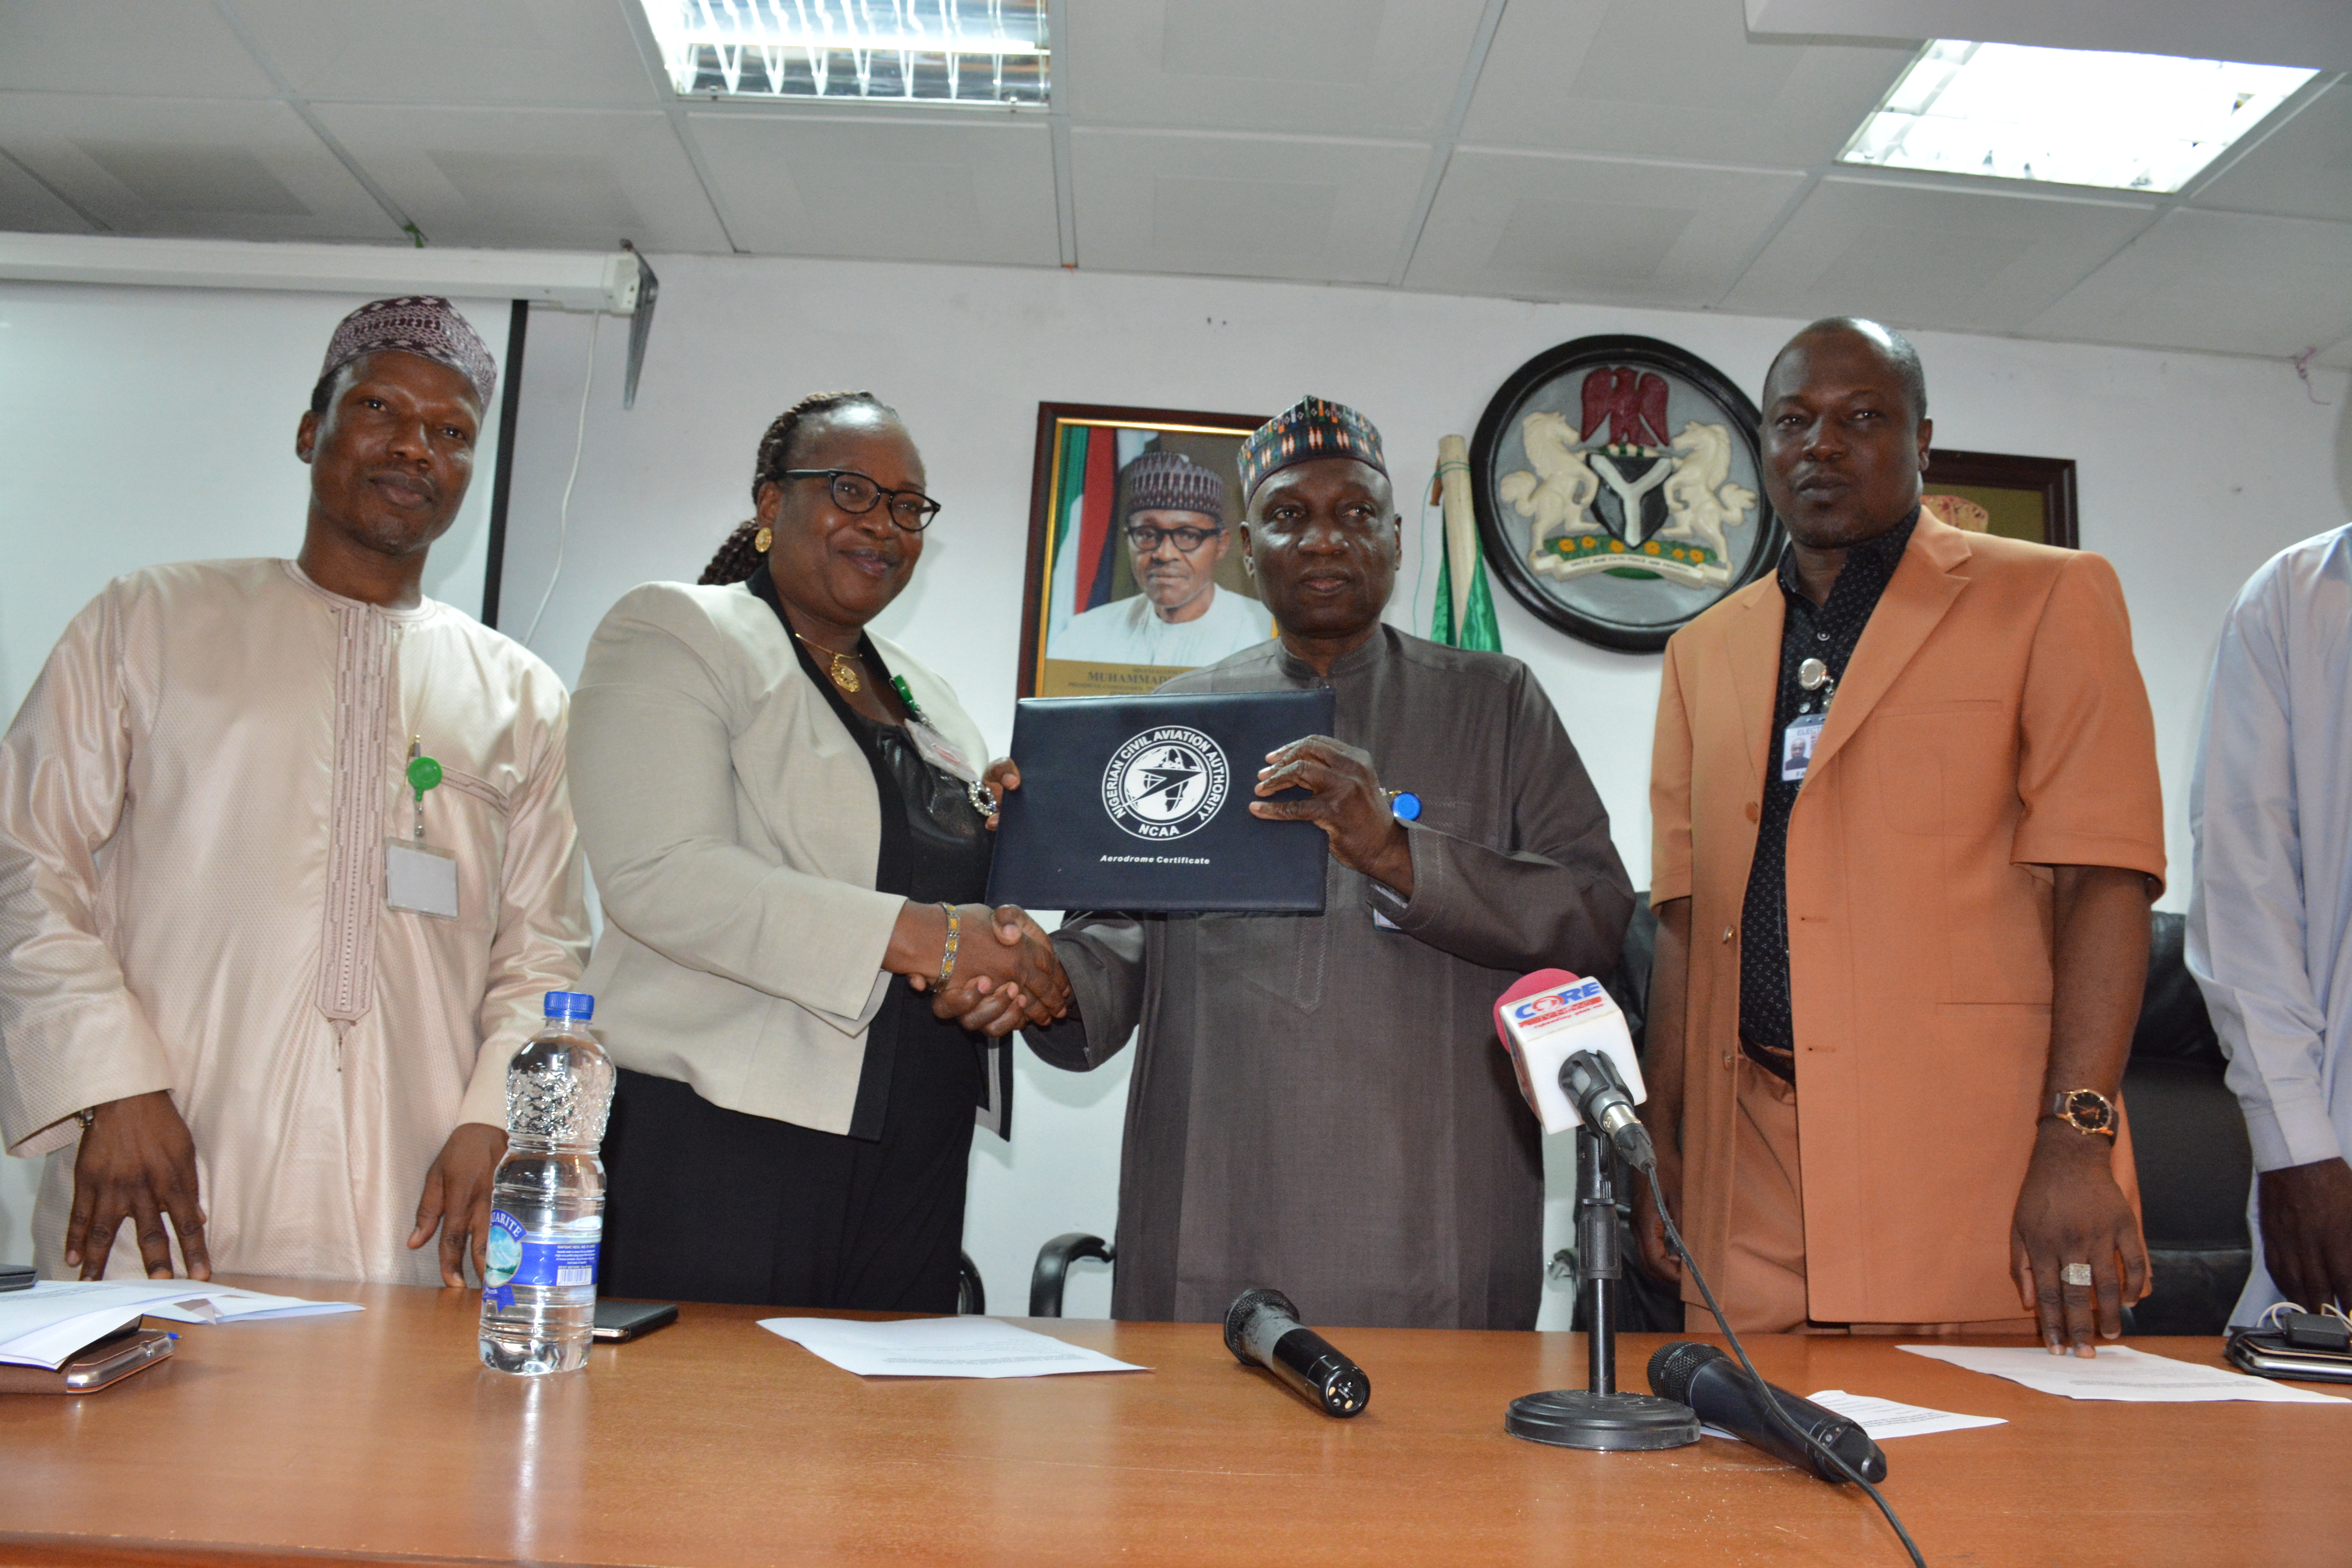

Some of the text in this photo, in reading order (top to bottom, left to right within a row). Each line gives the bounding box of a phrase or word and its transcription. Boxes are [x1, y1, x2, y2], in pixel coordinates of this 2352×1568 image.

[1088, 671, 1171, 684] MUHAMMAD
[1106, 730, 1225, 821] NIGERIAN CIVIL AVIATION AUTHORITY
[1138, 824, 1180, 837] NCAA
[1100, 855, 1210, 864] Aerodrome Certificate
[1515, 982, 1601, 1018] CORE
[490, 1212, 522, 1237] UARITE
